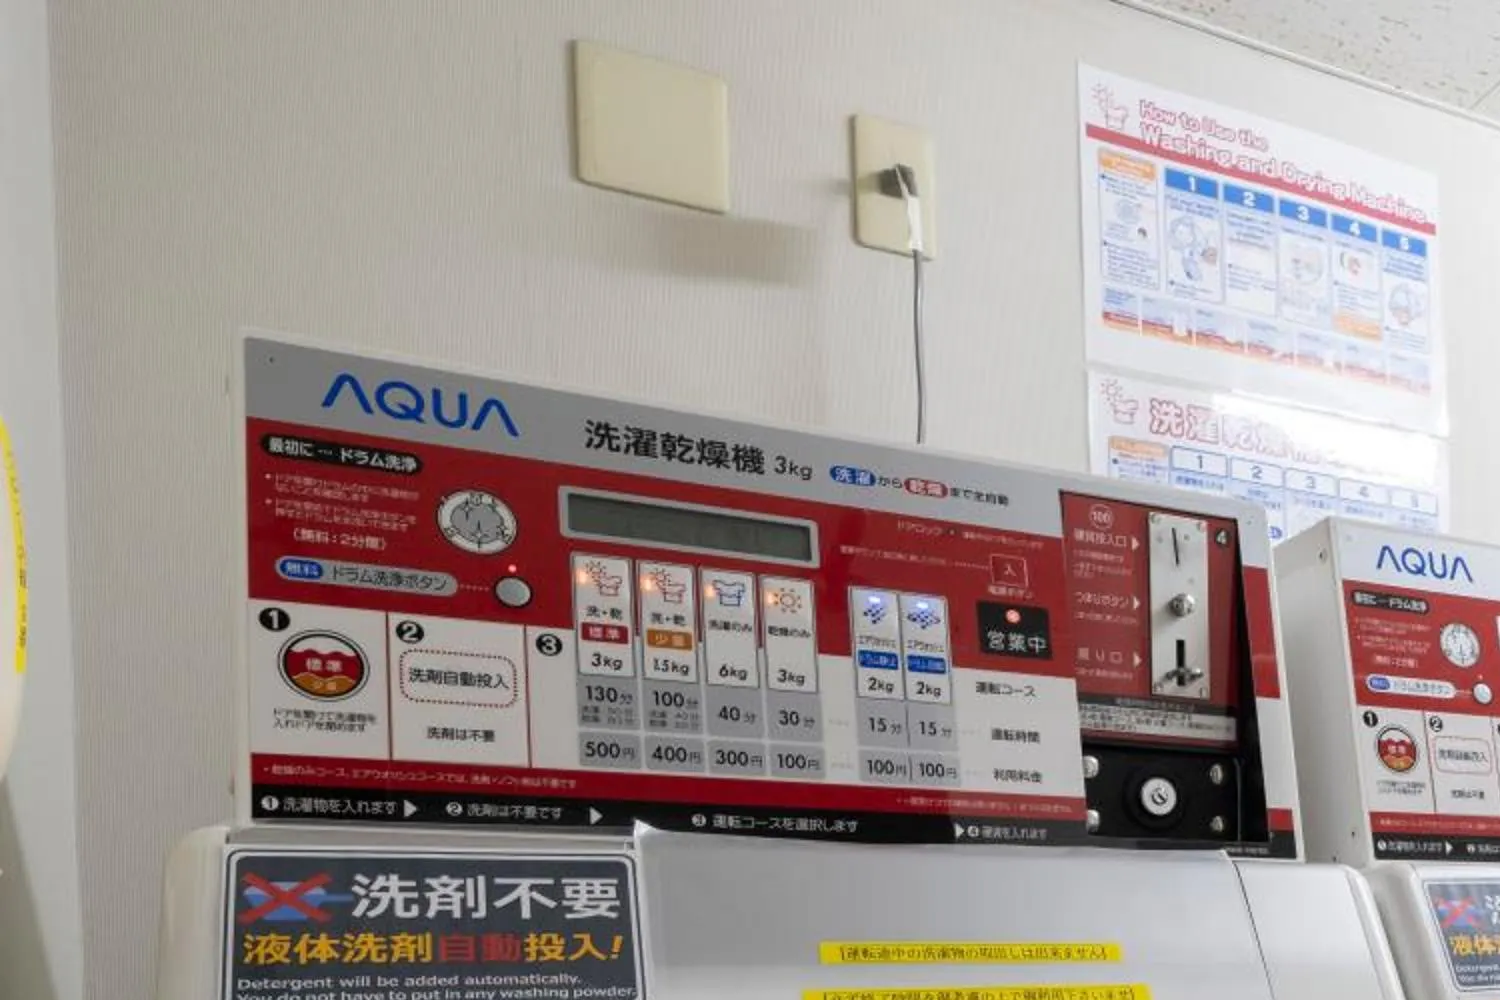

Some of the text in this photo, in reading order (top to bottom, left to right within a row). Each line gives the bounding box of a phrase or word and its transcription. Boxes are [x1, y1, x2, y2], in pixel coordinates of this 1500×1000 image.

[1140, 100, 1176, 126] How
[1179, 112, 1200, 131] to
[1239, 130, 1269, 152] the
[1140, 121, 1231, 165] Washing
[1236, 154, 1277, 178] and
[321, 373, 519, 437] AQUA
[584, 418, 813, 480] 洗濯乾燥機 3kg
[1377, 545, 1473, 583] AQUA
[987, 630, 1048, 654] 営業中
[591, 653, 623, 671] 3kg
[408, 667, 510, 691] 洗剤自動投入
[719, 665, 748, 681] 6kg
[776, 669, 805, 686] 3kg
[867, 677, 895, 694] 2kg
[915, 681, 942, 697] 2kg
[975, 681, 1037, 699] 運転コース
[427, 726, 496, 743] 洗剤は不要
[991, 727, 1041, 744] 運転時間
[993, 768, 1043, 784] 利用料金
[283, 796, 397, 816] 洗濯物を入れます
[712, 814, 858, 834] 運転コースを選択します
[351, 873, 622, 921] 洗剤不要
[237, 973, 581, 992] Detergent will be added automatically.
[389, 990, 407, 1000] to
[445, 988, 462, 1000] in
[465, 988, 498, 1000] any
[499, 986, 569, 1000] washing
